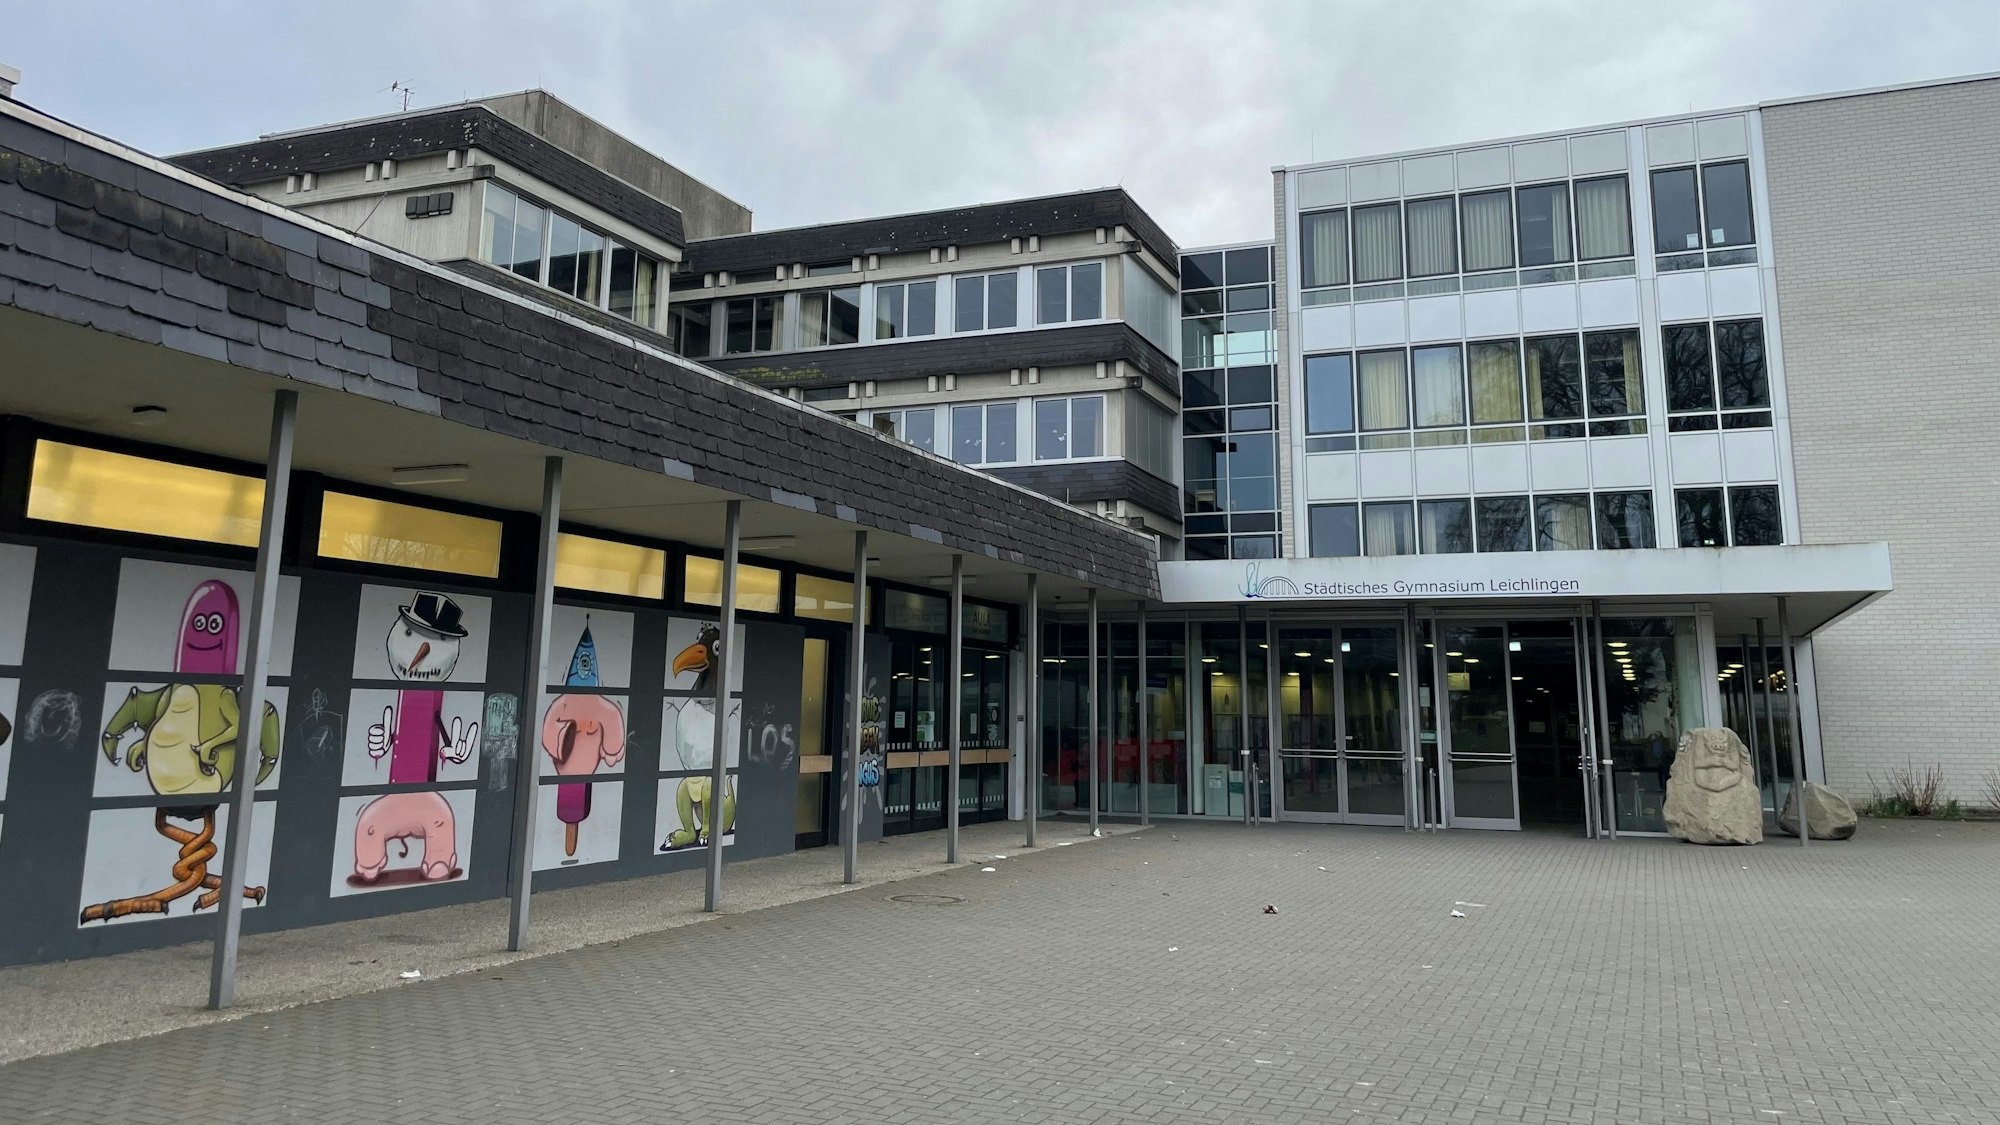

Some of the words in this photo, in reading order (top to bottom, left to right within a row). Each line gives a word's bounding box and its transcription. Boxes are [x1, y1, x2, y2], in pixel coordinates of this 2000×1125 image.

[1304, 581, 1388, 595] Städtisches
[1393, 580, 1485, 596] Gymnasium
[1490, 578, 1579, 594] Leichlingen
[972, 610, 992, 626] AULA
